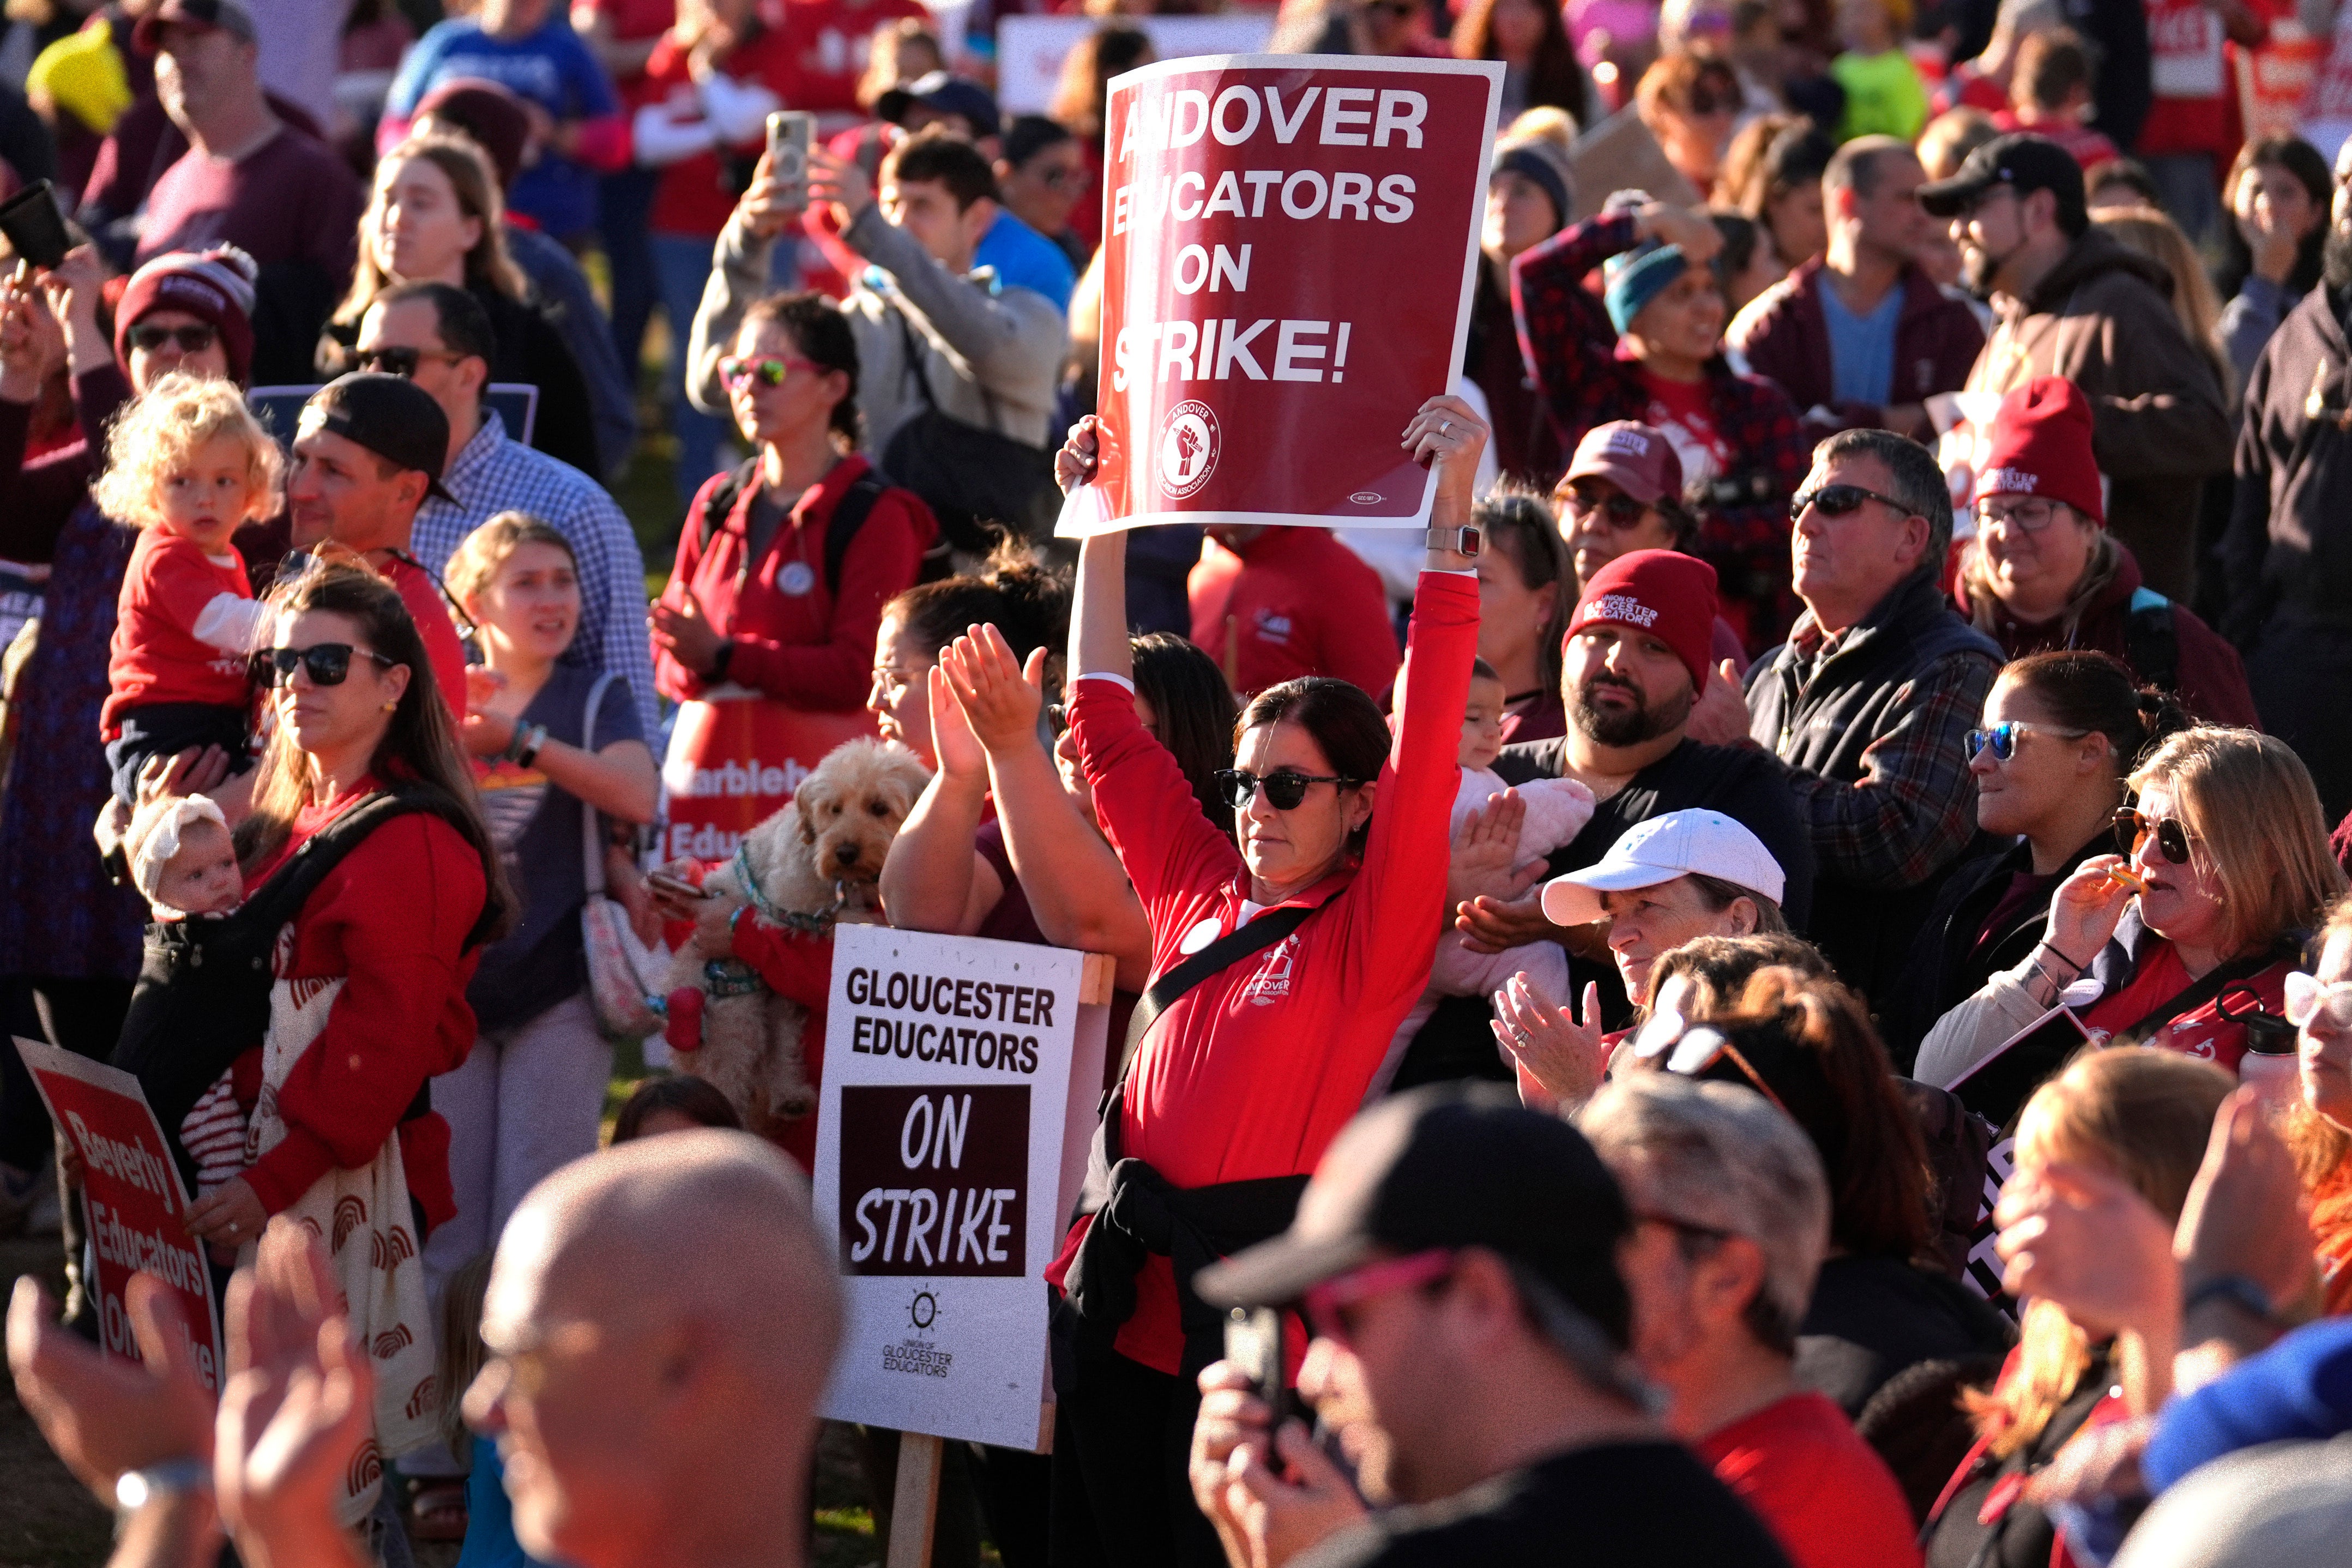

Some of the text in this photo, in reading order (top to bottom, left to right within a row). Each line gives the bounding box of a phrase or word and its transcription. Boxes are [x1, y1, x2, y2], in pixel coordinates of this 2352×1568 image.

[1119, 85, 1428, 162] ANDOVER
[1113, 170, 1416, 237] EDUCATORS
[1173, 244, 1252, 295] ON
[1113, 319, 1352, 393] STRIKE!
[1172, 403, 1209, 421] ANDOVER
[1177, 464, 1211, 496] ASSOCIATION
[1601, 594, 1625, 602] UNION
[847, 967, 1054, 1027] GLOUCESTER
[853, 1015, 1039, 1074] EDUCATORS
[901, 1094, 972, 1168] ON
[64, 1108, 173, 1215] Beverly
[91, 1200, 204, 1296] Educators
[851, 1187, 1016, 1267] STRIKE
[883, 1344, 952, 1366] GLOUCESTER
[884, 1358, 948, 1378] EDUCATORS
